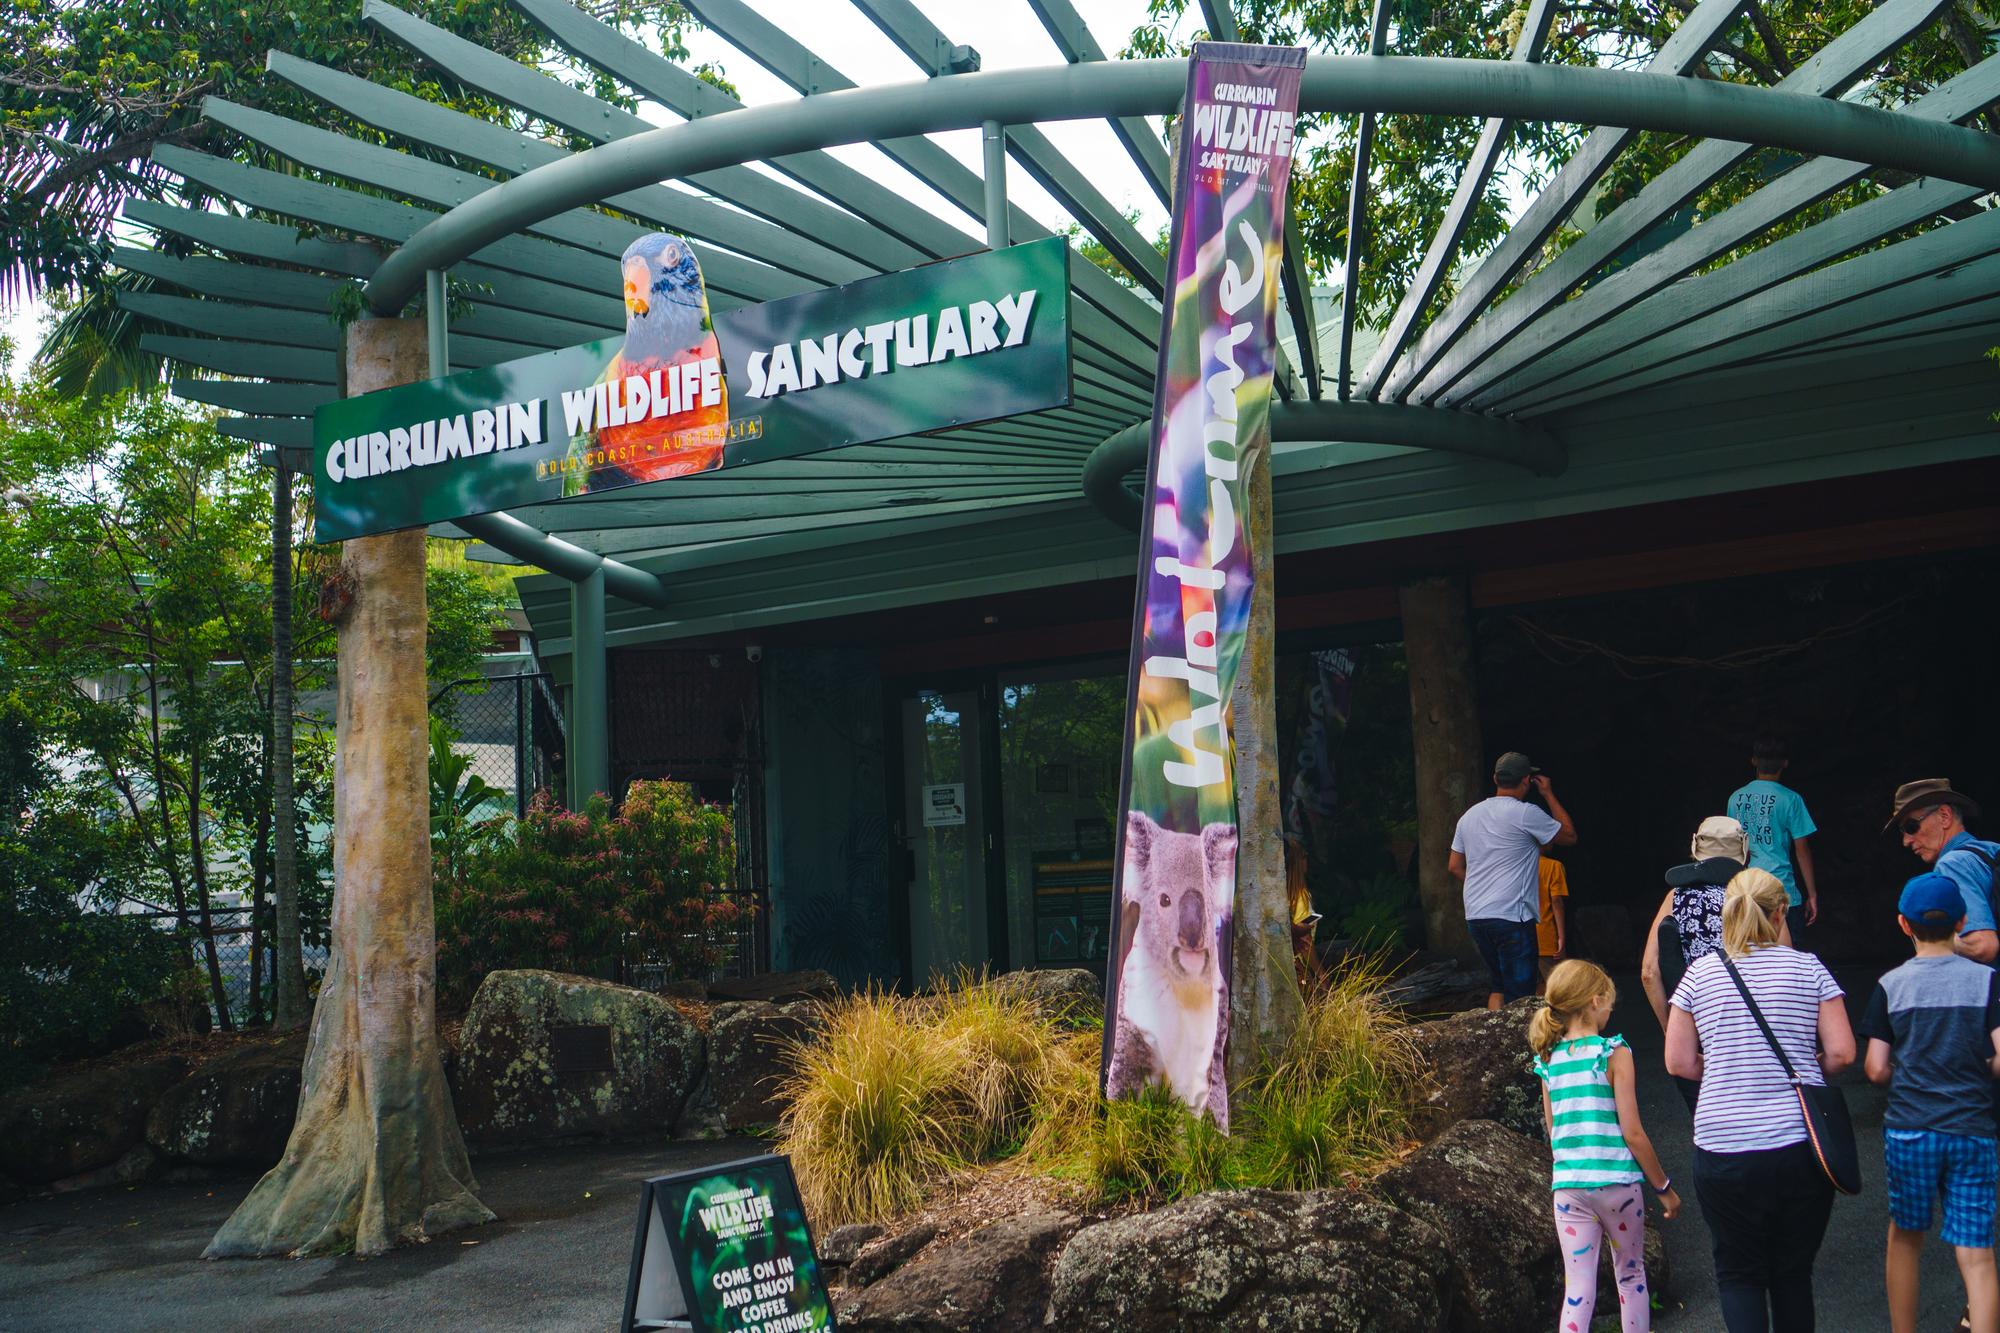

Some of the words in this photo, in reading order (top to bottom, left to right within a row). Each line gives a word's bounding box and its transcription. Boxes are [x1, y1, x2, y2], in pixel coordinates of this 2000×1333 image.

[1214, 82, 1278, 107] CURRUMBIN
[1193, 103, 1295, 158] WILDLIFE
[325, 397, 542, 484] CURRUMBIN
[561, 356, 721, 437] WILDLIFE
[744, 289, 1037, 399] SANCTUARY
[538, 456, 577, 476] GOLD
[586, 443, 638, 466] COAST
[662, 419, 759, 451] AUSTRALIA
[698, 1195, 774, 1232] WILDLIFE
[712, 1266, 752, 1290] COME
[753, 1260, 777, 1280] ON
[776, 1255, 795, 1275] IN
[722, 1287, 752, 1309] AND
[753, 1275, 795, 1301] ENJOY
[741, 1297, 788, 1324] COFFEE
[763, 1310, 814, 1333] DRINKS
